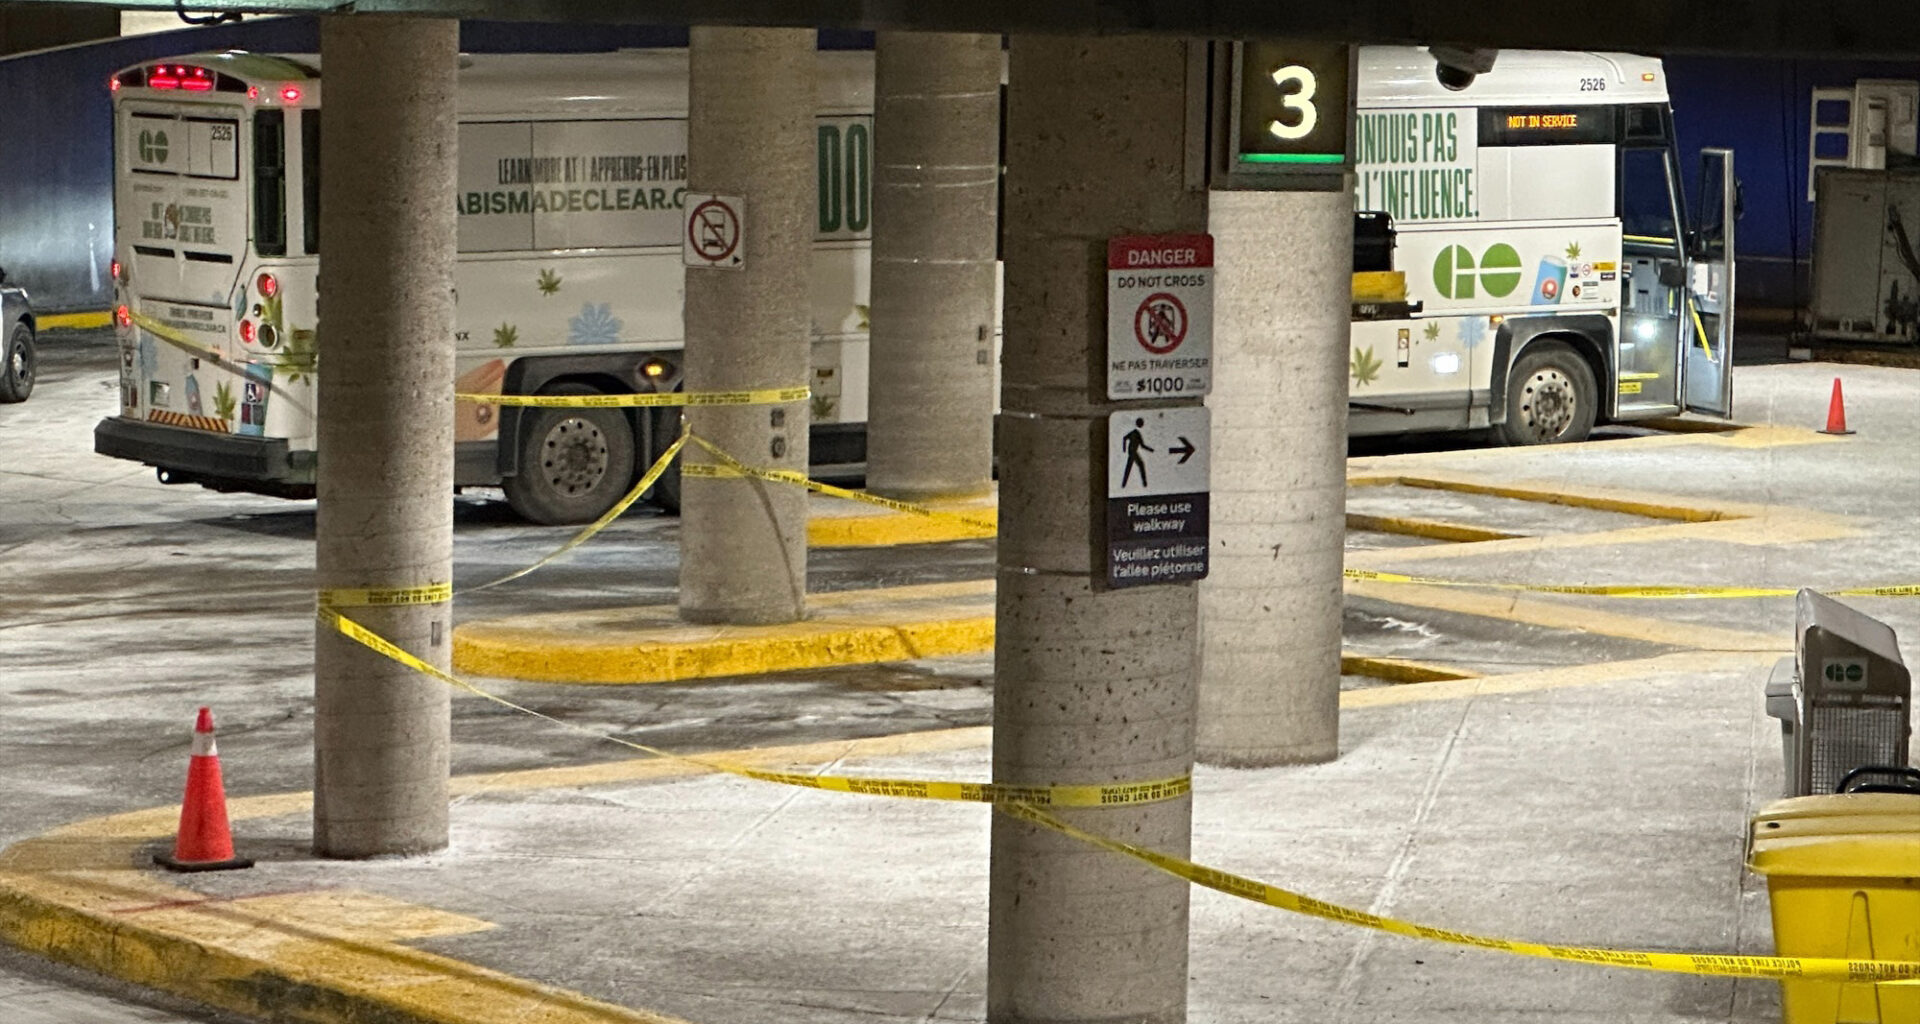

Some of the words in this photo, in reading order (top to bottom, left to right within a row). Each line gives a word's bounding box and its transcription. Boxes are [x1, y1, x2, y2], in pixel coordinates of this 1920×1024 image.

[1580, 77, 1606, 91] 2526
[1270, 65, 1317, 139] 3
[1508, 116, 1526, 128] NOT
[1529, 115, 1540, 128] IN
[1542, 114, 1577, 127] SERVICE
[211, 125, 232, 141] 2526
[1422, 112, 1457, 162] PAS
[139, 129, 168, 163] GO
[498, 158, 532, 184] LEARN
[534, 157, 562, 183] MORE
[565, 157, 577, 182] AT
[662, 155, 687, 181] PLUS
[1128, 249, 1196, 266] DANGER
[1433, 243, 1522, 299] GO
[1118, 277, 1135, 289] DO
[1138, 276, 1162, 288] NOT
[1164, 275, 1205, 287] CROSS
[1112, 361, 1126, 371] NE
[1128, 360, 1147, 371] PAS
[1149, 358, 1208, 370] TRAVERSER
[1136, 377, 1184, 393] $1000
[1127, 503, 1167, 516] Please
[1169, 502, 1192, 514] use
[1133, 518, 1185, 532] walkway
[1113, 547, 1160, 561] Veuillez
[1162, 544, 1205, 558] utiliser
